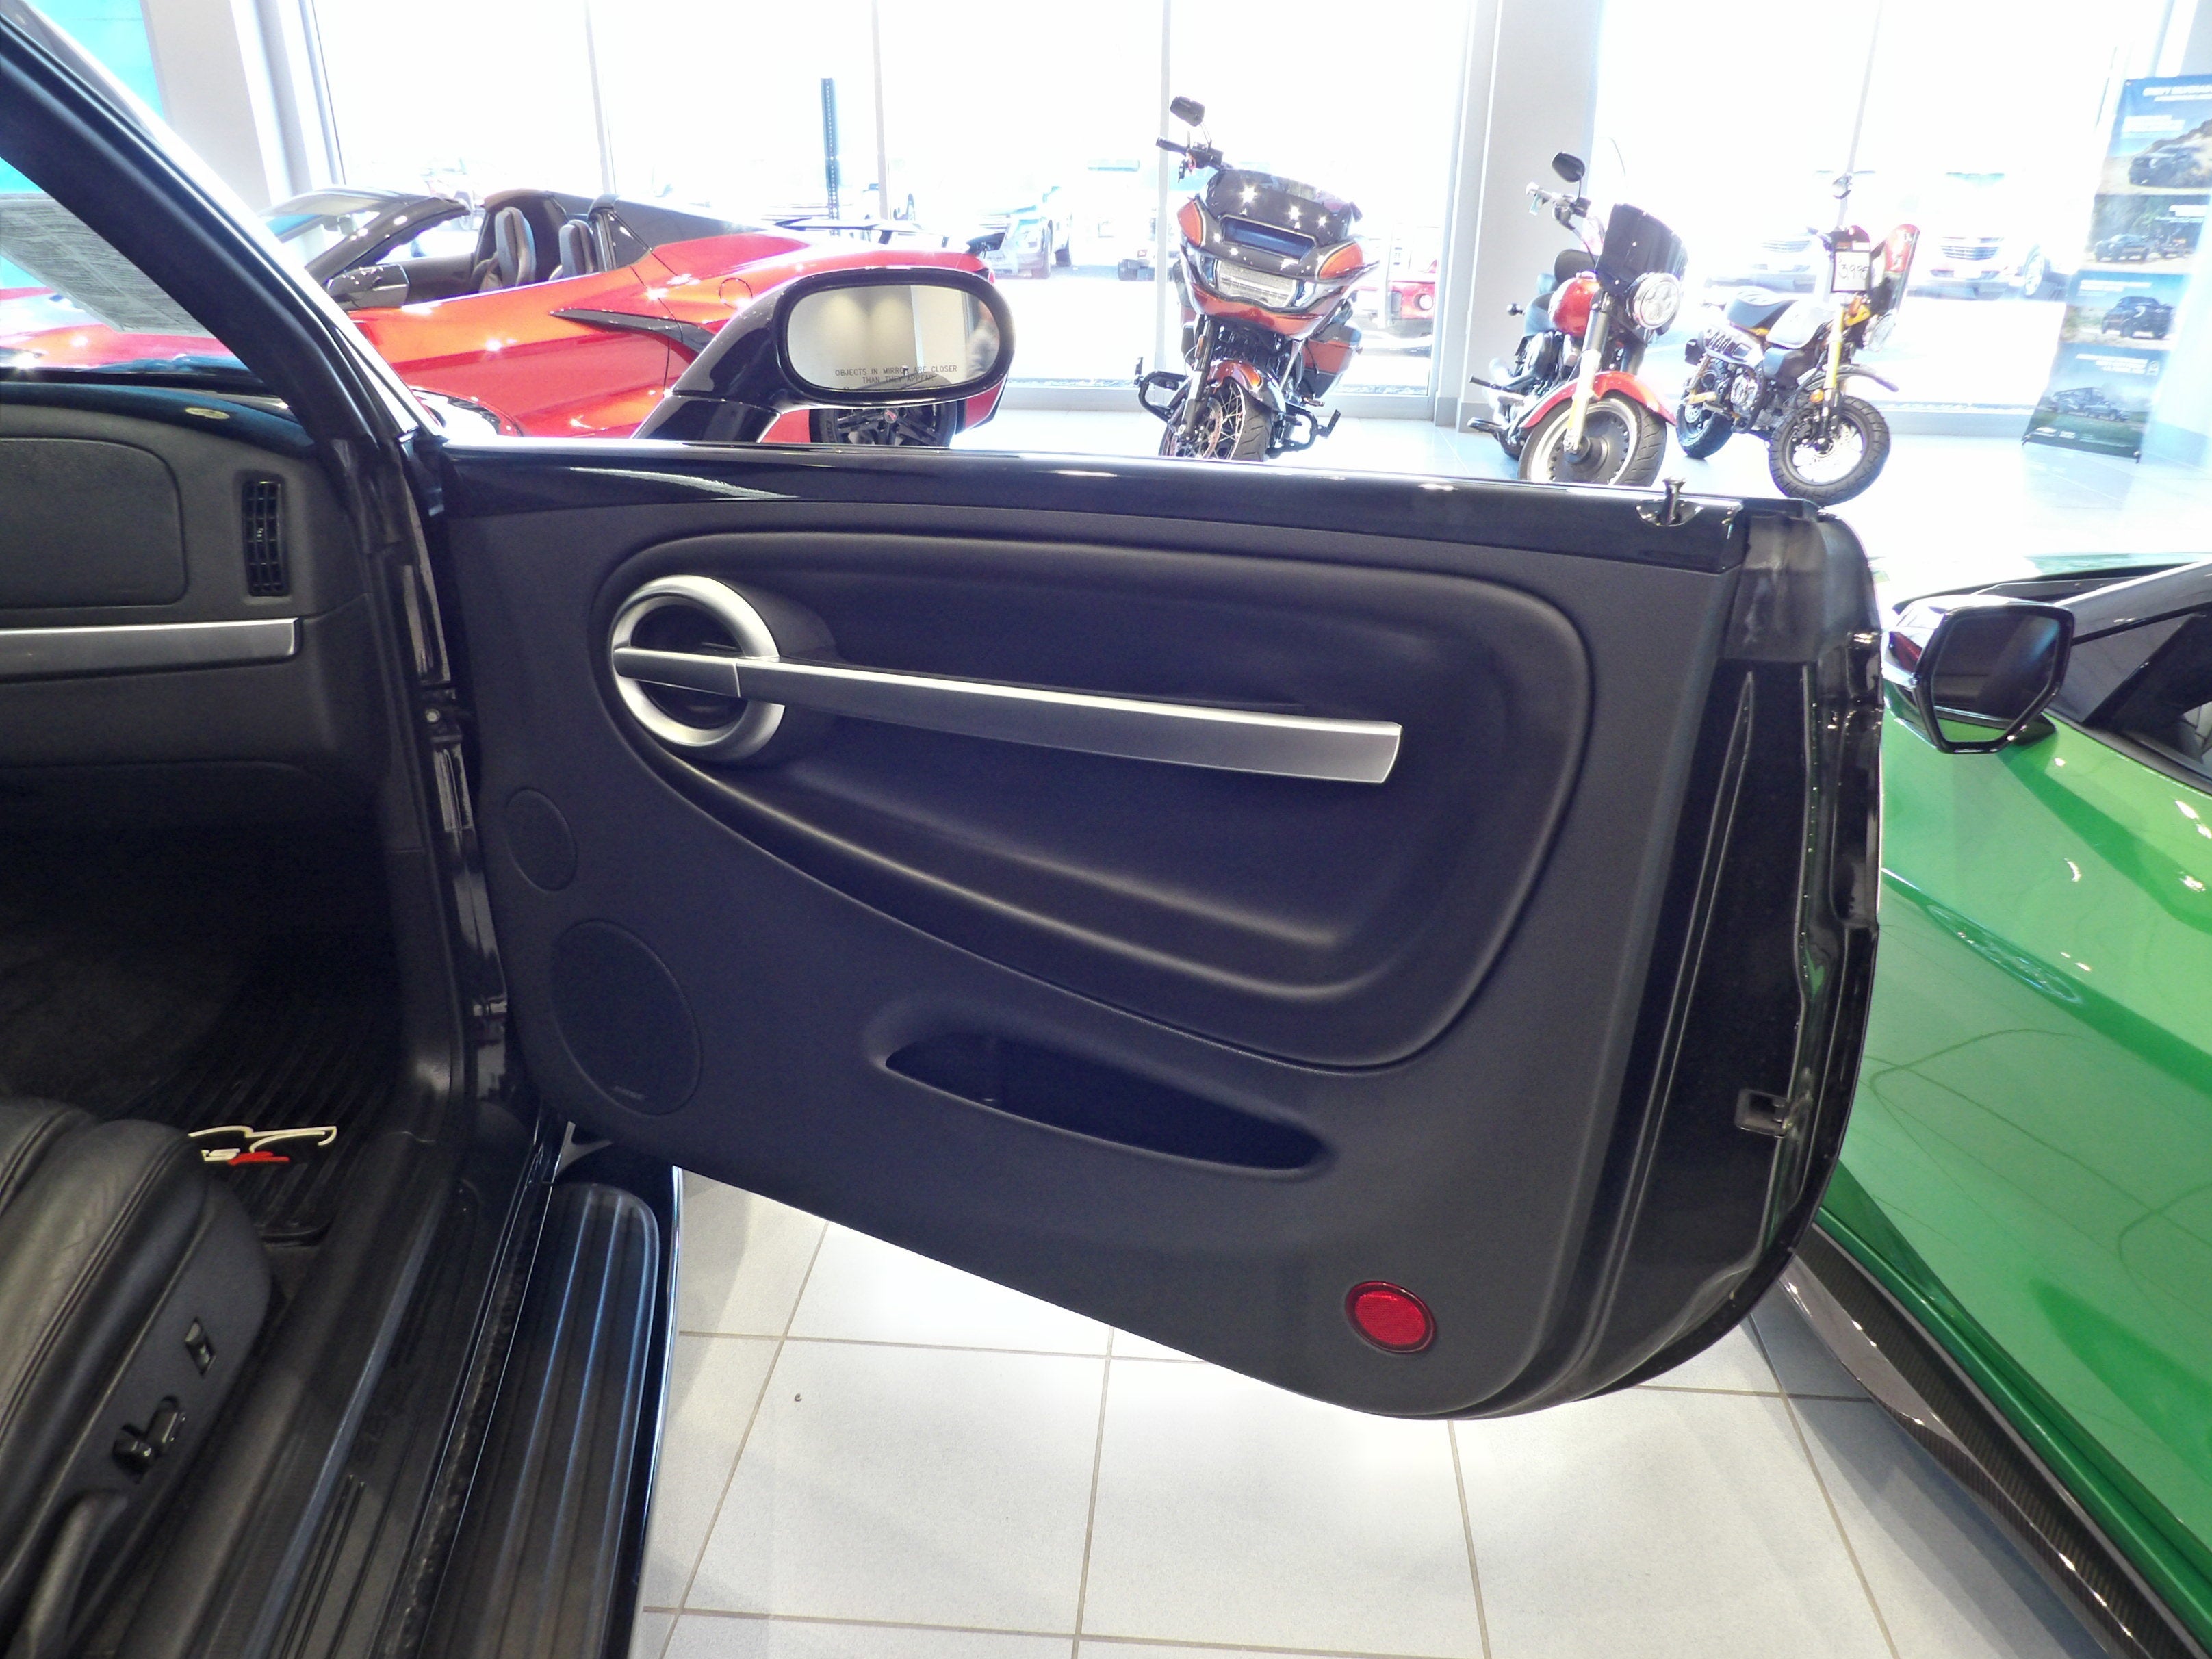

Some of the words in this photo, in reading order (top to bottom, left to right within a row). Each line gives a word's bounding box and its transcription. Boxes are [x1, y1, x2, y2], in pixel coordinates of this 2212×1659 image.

[835, 368, 866, 376] OBJECTS
[931, 365, 957, 373] CLOSER
[907, 374, 934, 383] APPEAR
